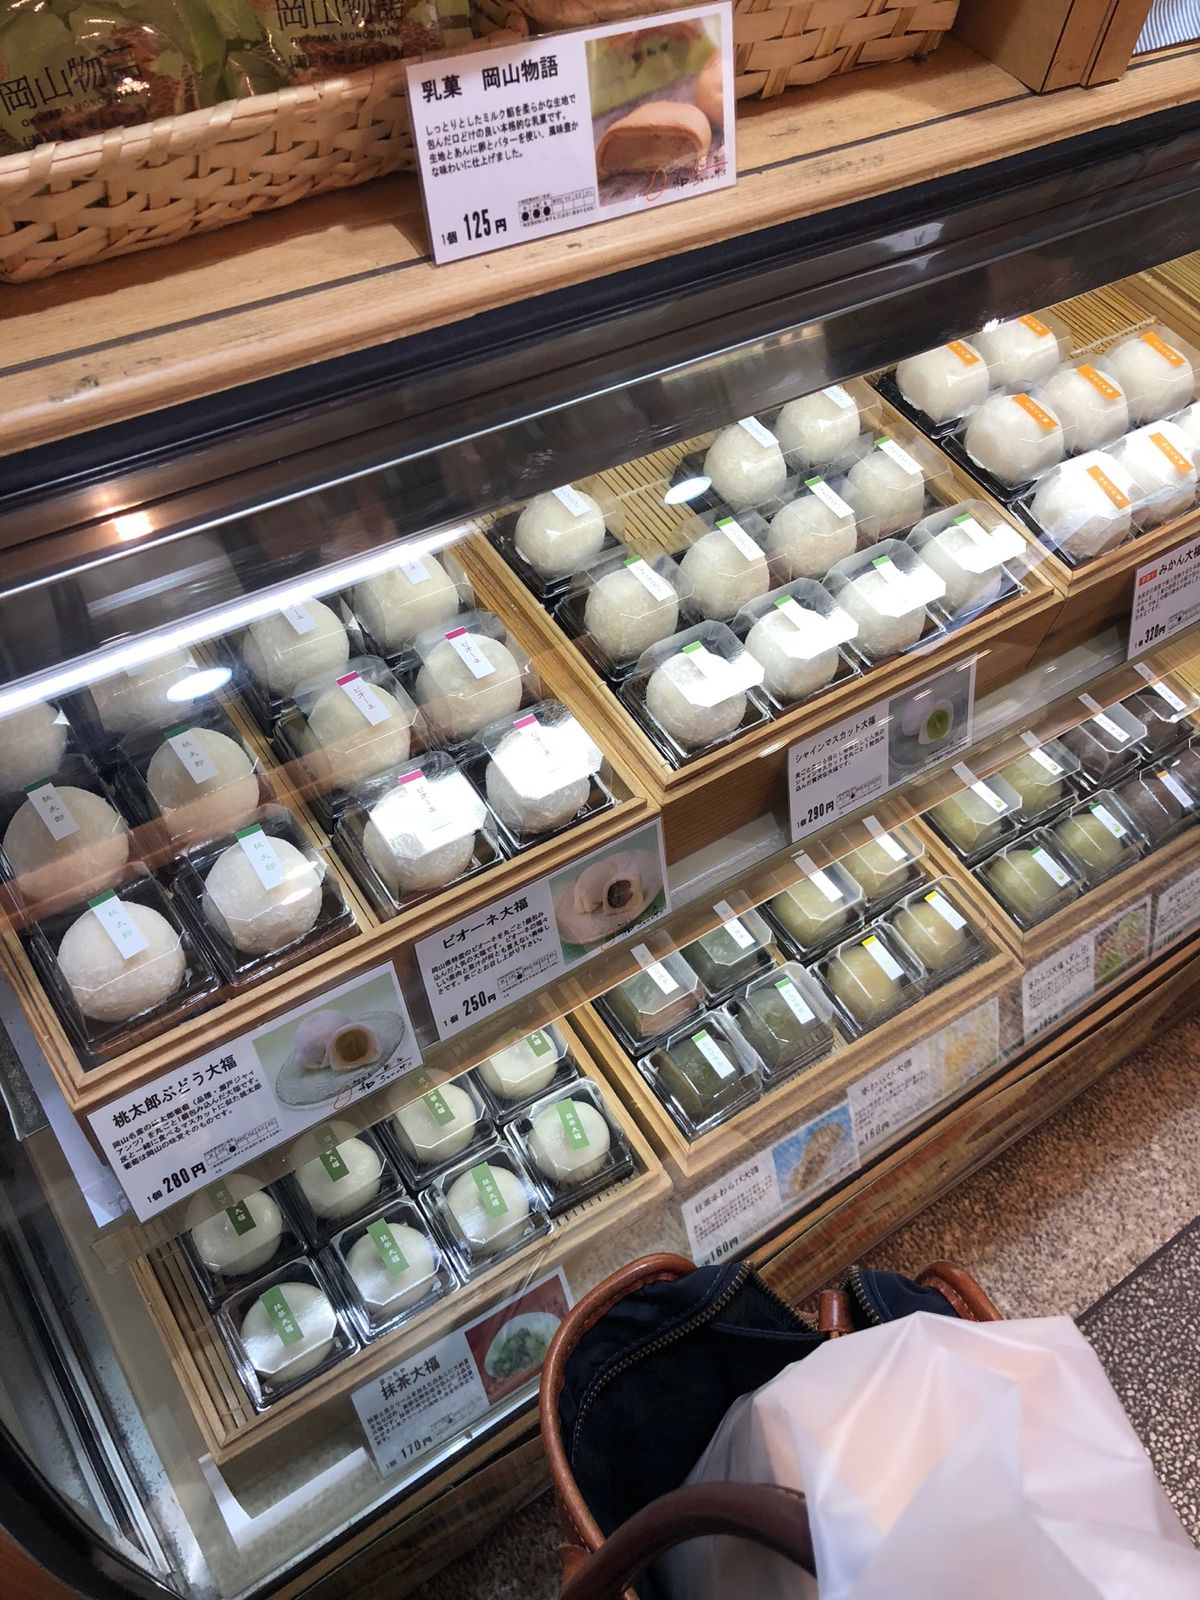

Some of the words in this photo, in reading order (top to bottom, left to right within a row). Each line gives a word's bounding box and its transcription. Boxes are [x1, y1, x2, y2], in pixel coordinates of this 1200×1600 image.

[420, 74, 462, 104] 乳菓
[482, 55, 559, 92] 岡山物語
[431, 147, 524, 178] な味わいに仕上げました。
[795, 715, 876, 763] シャインマスカット大福
[443, 896, 529, 950] ピオーネ大福
[112, 1054, 238, 1129] 桃太郎ぶどう大福
[566, 1111, 583, 1141] 抹茶大福
[481, 1178, 502, 1207] 抹茶大福
[379, 1234, 401, 1264] 抹茶大福
[273, 1303, 295, 1334] 抹茶大福
[380, 1354, 441, 1401] 抹茶大福
